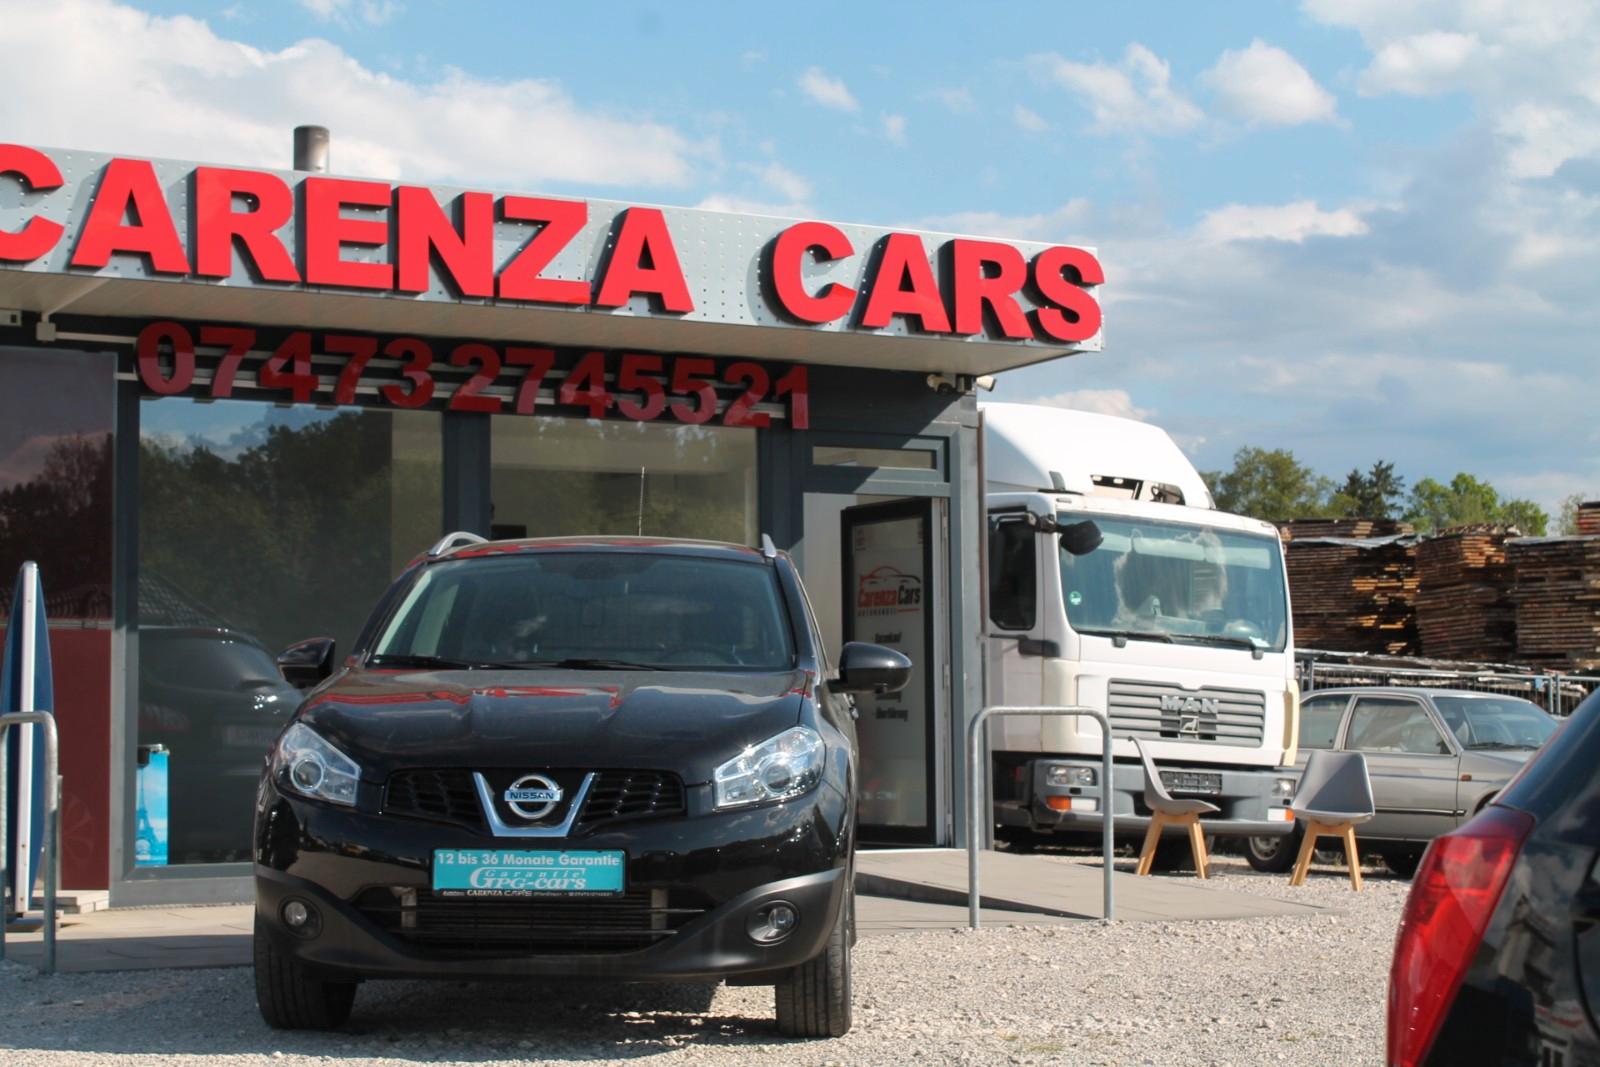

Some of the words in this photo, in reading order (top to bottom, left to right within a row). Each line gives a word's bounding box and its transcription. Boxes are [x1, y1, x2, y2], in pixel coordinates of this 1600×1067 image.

[0, 143, 693, 314] CARENZA
[772, 221, 1105, 342] CARS
[1161, 695, 1218, 714] MAN
[510, 791, 554, 799] NISSAN
[438, 853, 453, 864] 12
[458, 853, 478, 865] bis
[482, 853, 498, 865] 36
[503, 853, 554, 865] Monate
[559, 853, 620, 866] Garantie
